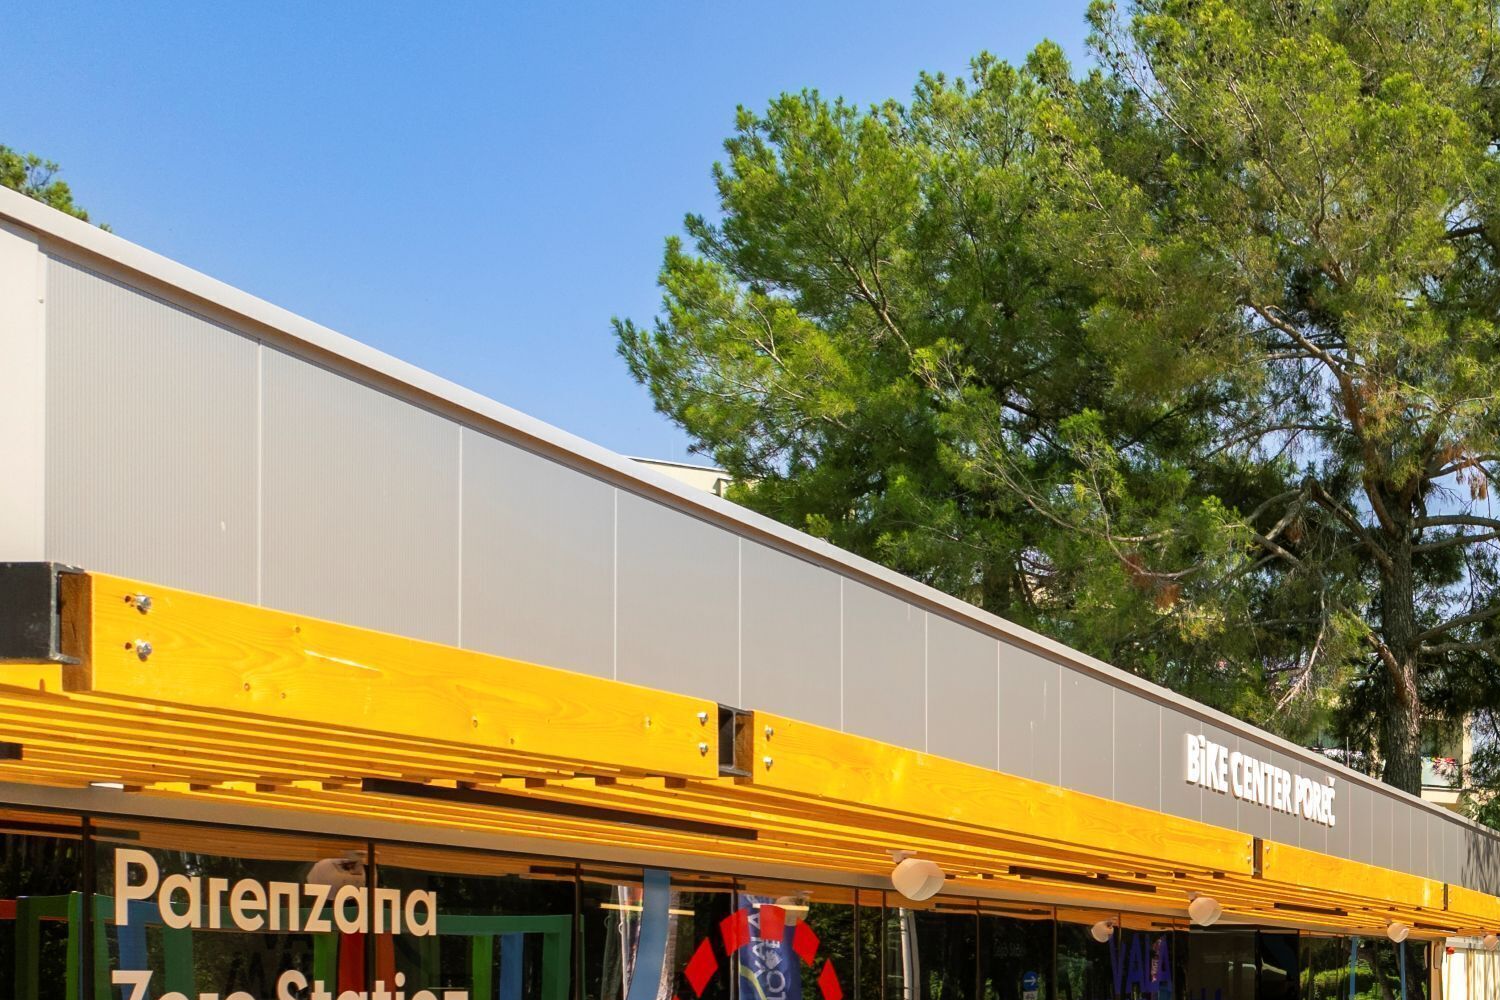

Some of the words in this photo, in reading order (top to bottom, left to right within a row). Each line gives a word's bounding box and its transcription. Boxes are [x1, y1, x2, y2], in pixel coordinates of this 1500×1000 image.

[1230, 751, 1292, 813] CENTER
[1294, 775, 1336, 827] POREČ
[114, 847, 437, 937] Parenzana
